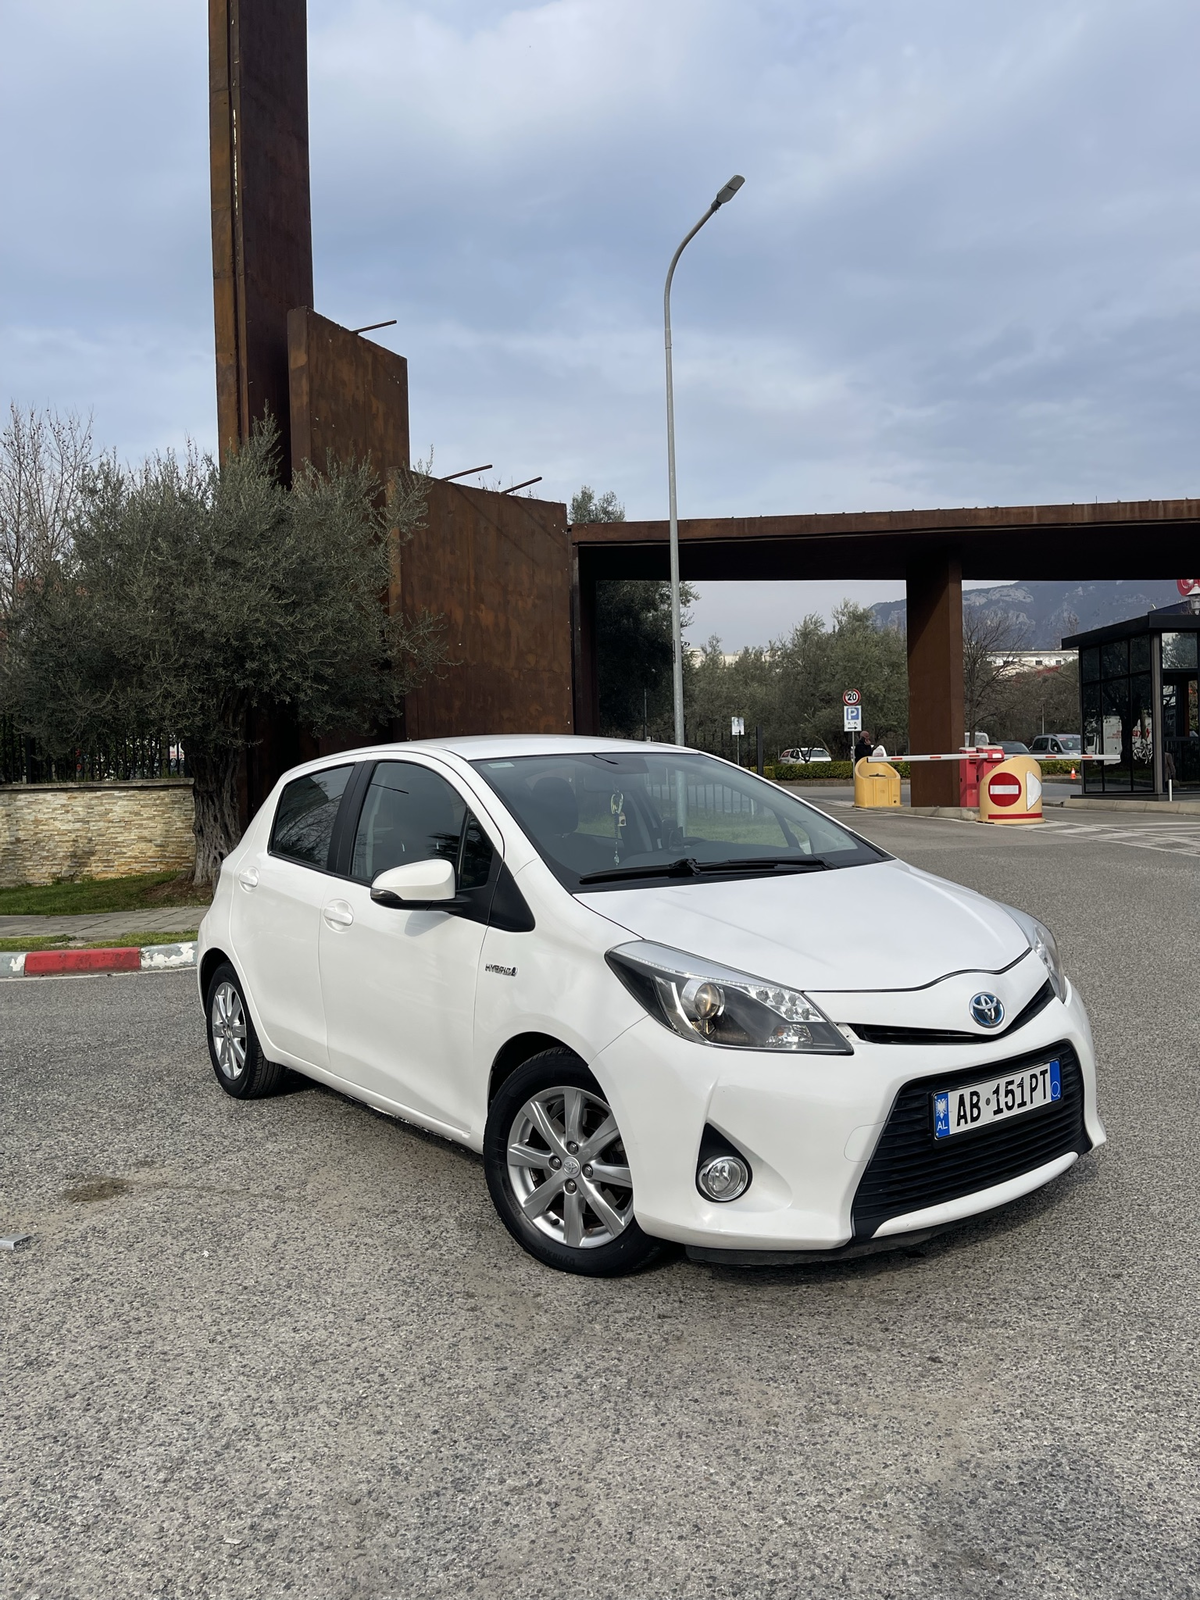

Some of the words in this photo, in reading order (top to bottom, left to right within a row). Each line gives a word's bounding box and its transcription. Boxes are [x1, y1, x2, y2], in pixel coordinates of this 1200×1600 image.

[847, 693, 857, 701] 20
[848, 708, 857, 720] P
[957, 1091, 981, 1126] AB
[936, 1121, 948, 1131] AL
